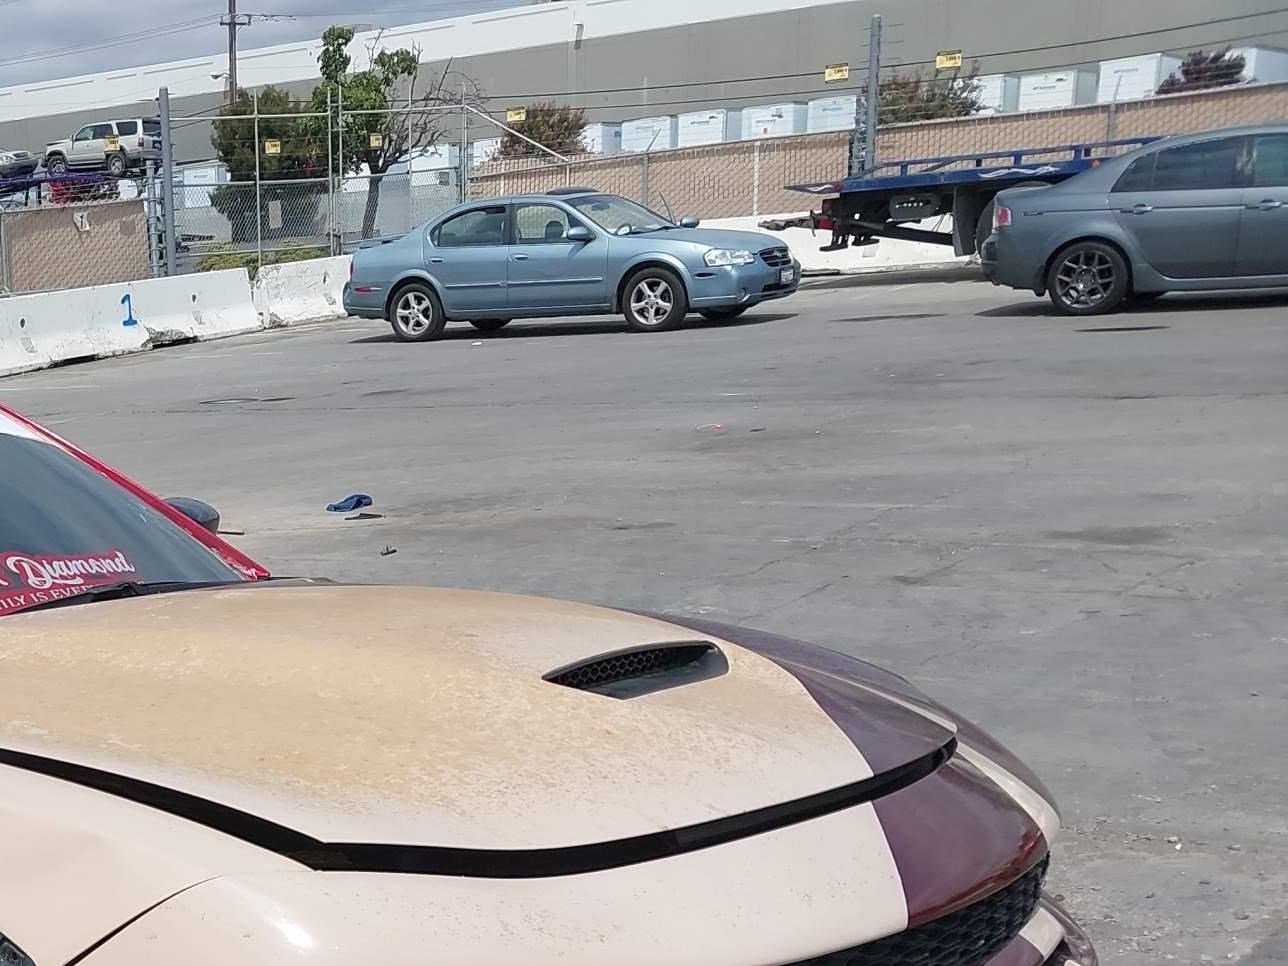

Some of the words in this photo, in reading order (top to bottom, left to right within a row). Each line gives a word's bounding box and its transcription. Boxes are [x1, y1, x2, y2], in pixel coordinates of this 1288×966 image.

[120, 293, 138, 326] 1
[7, 551, 136, 588] Diamond
[30, 591, 49, 603] IS
